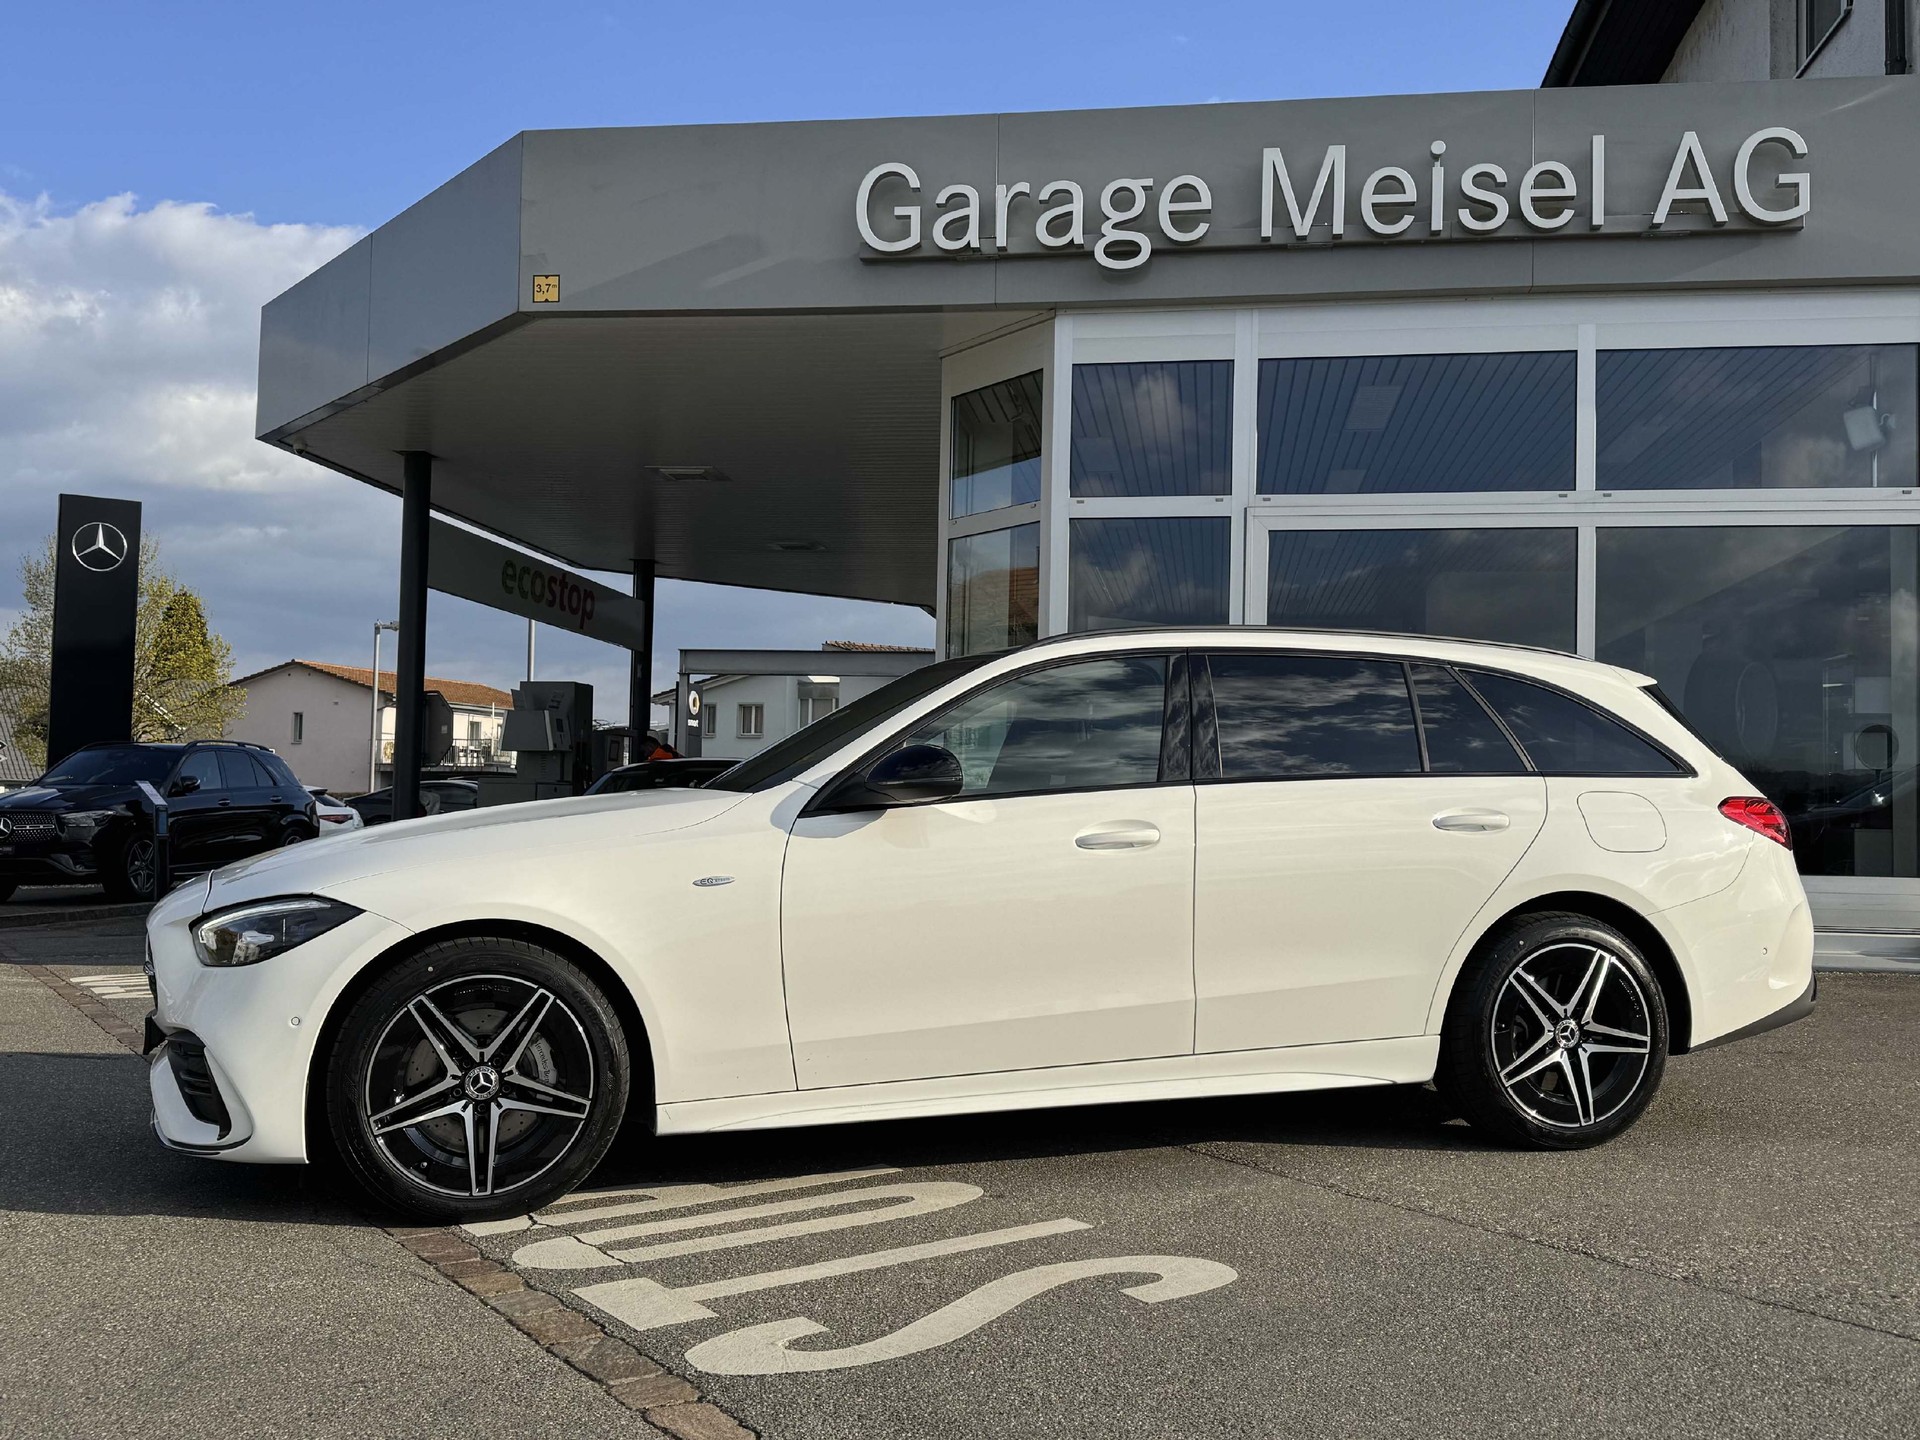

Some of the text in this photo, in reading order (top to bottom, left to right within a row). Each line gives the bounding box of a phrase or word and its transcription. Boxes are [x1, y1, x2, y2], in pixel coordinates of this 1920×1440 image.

[856, 126, 1811, 270] Garage Meisel AG
[501, 560, 596, 630] ecostop
[459, 1164, 1239, 1377] STOP
